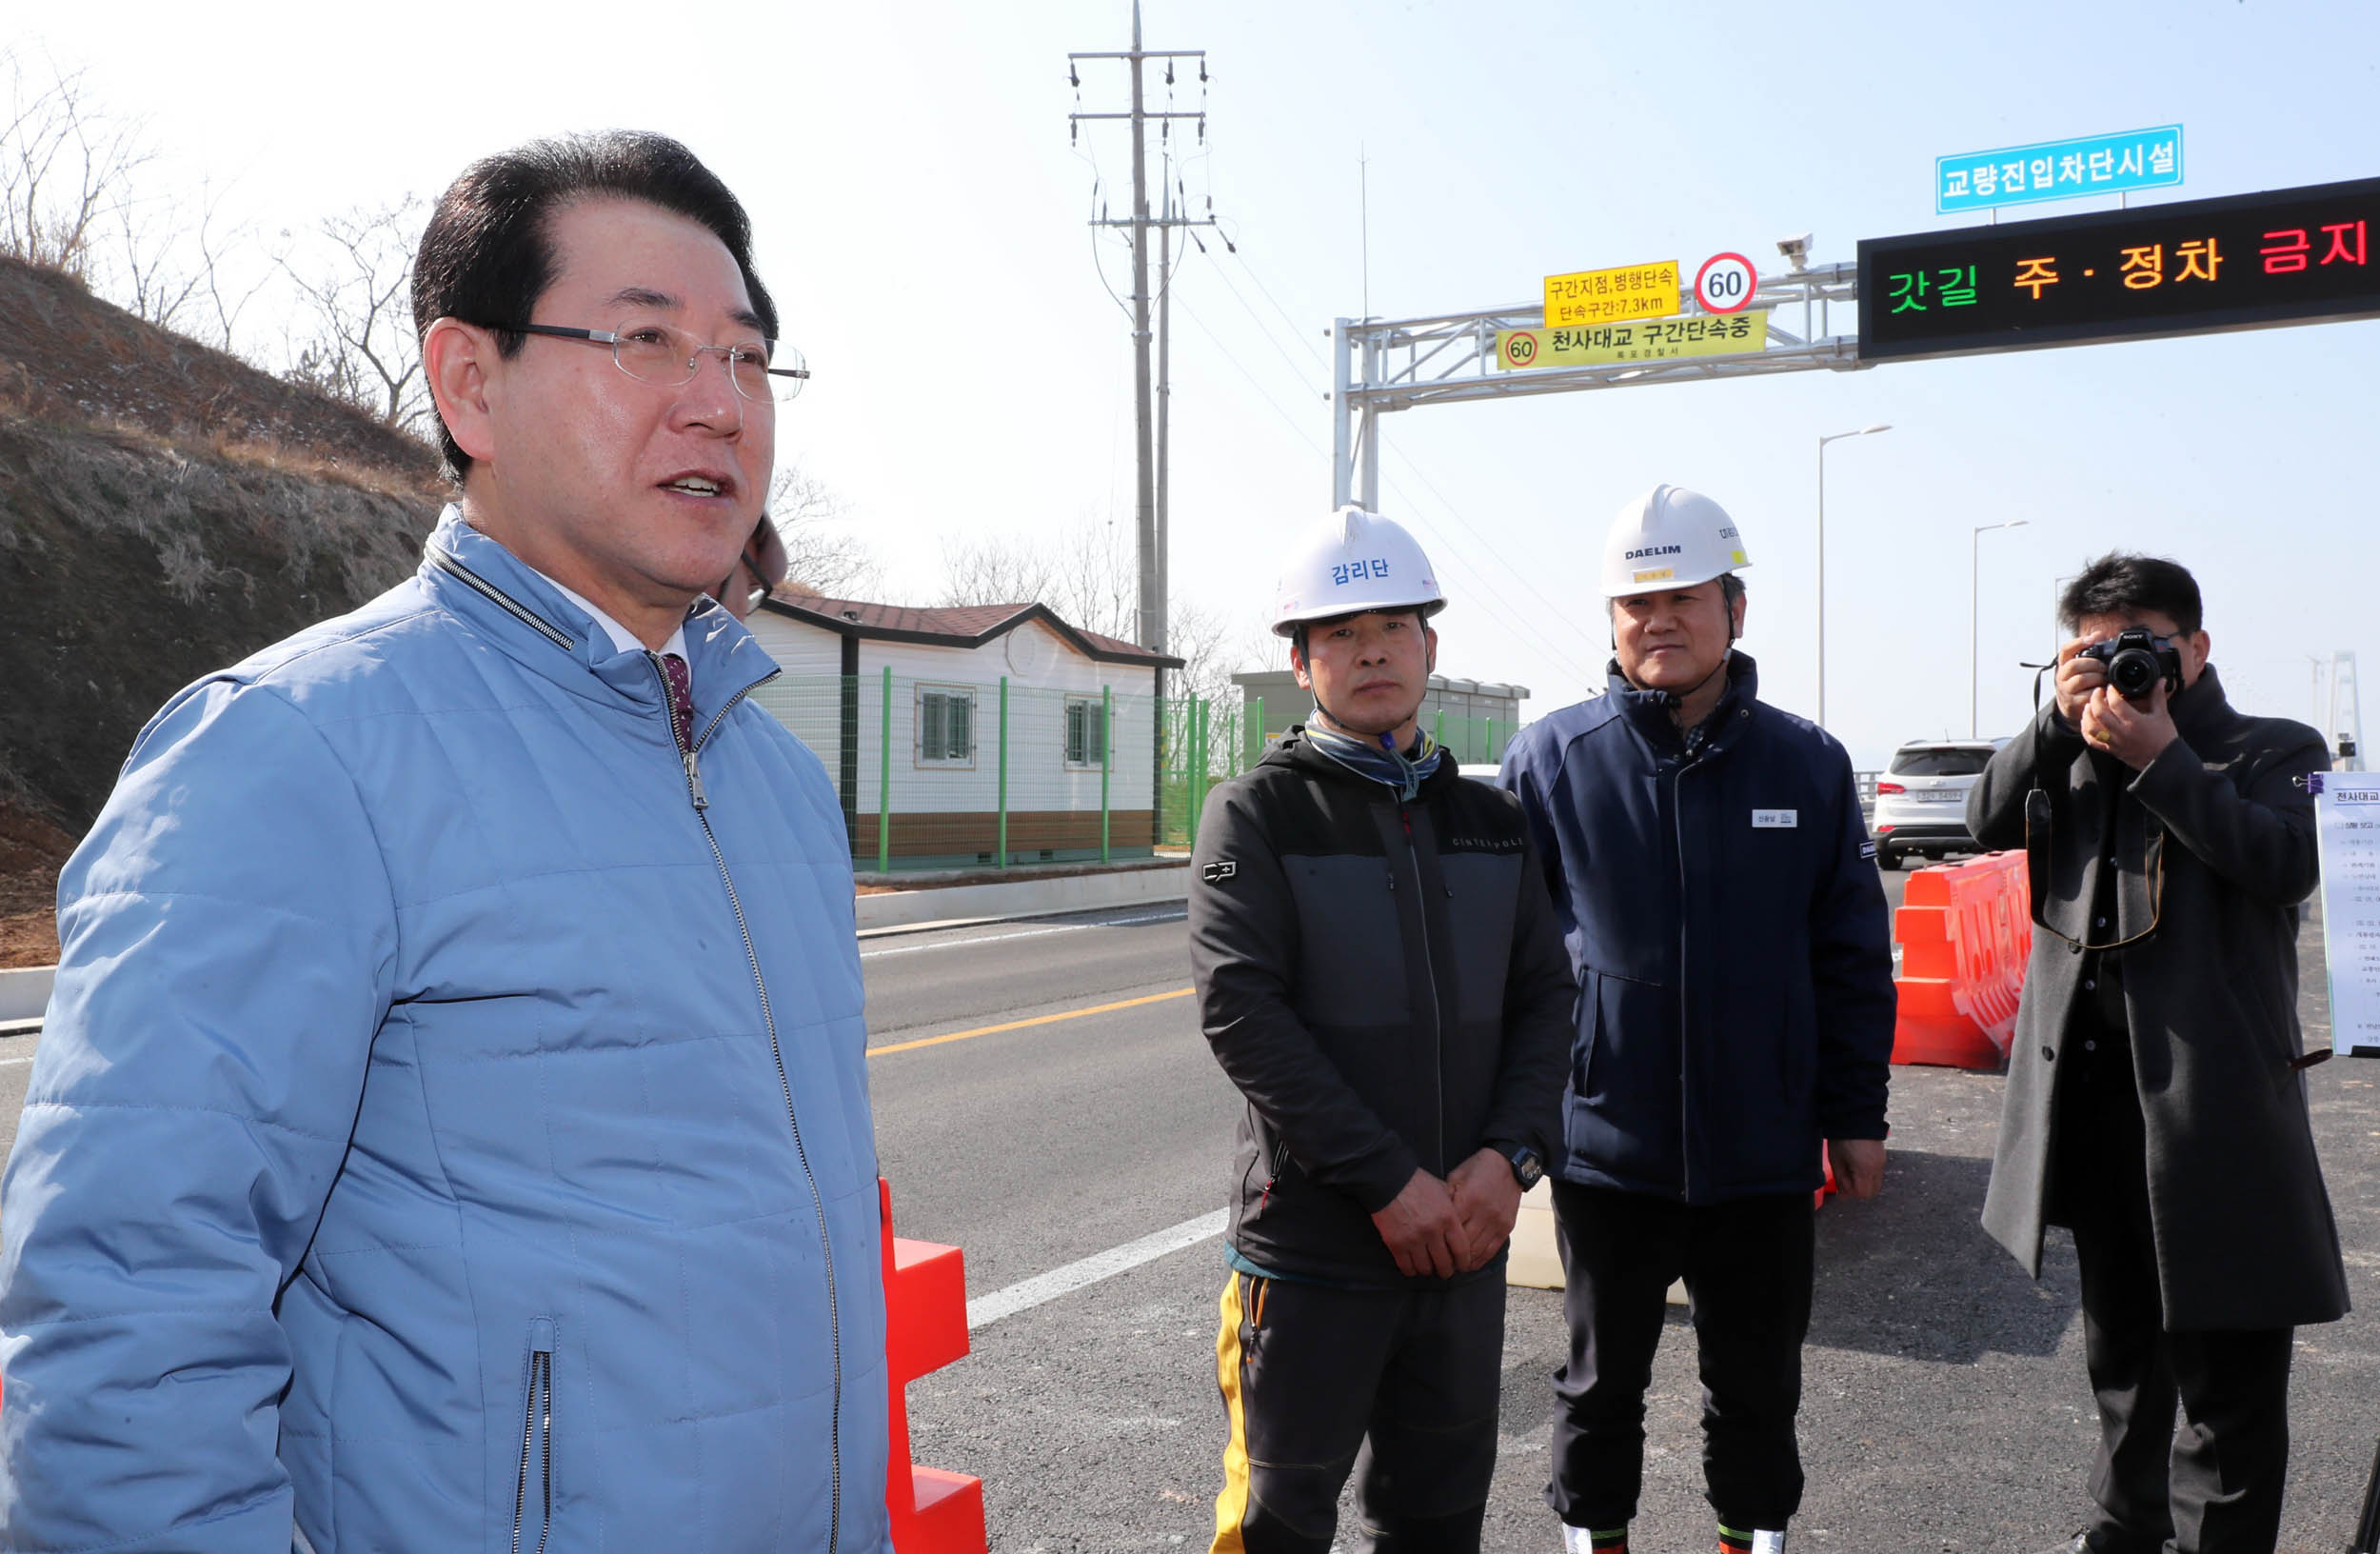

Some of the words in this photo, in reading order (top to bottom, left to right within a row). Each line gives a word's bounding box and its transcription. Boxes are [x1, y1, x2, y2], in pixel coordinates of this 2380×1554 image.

[1943, 140, 2176, 199] 교량진입차단시설
[1889, 265, 1978, 314] 갓길
[2259, 220, 2368, 274] 금지
[1708, 271, 1742, 298] 60
[1552, 329, 1634, 352] 천사대교
[1643, 316, 1751, 345] 구간단속중
[1510, 341, 1533, 358] 60
[1625, 545, 1682, 560] DAELIM
[1332, 558, 1389, 586] 감리단
